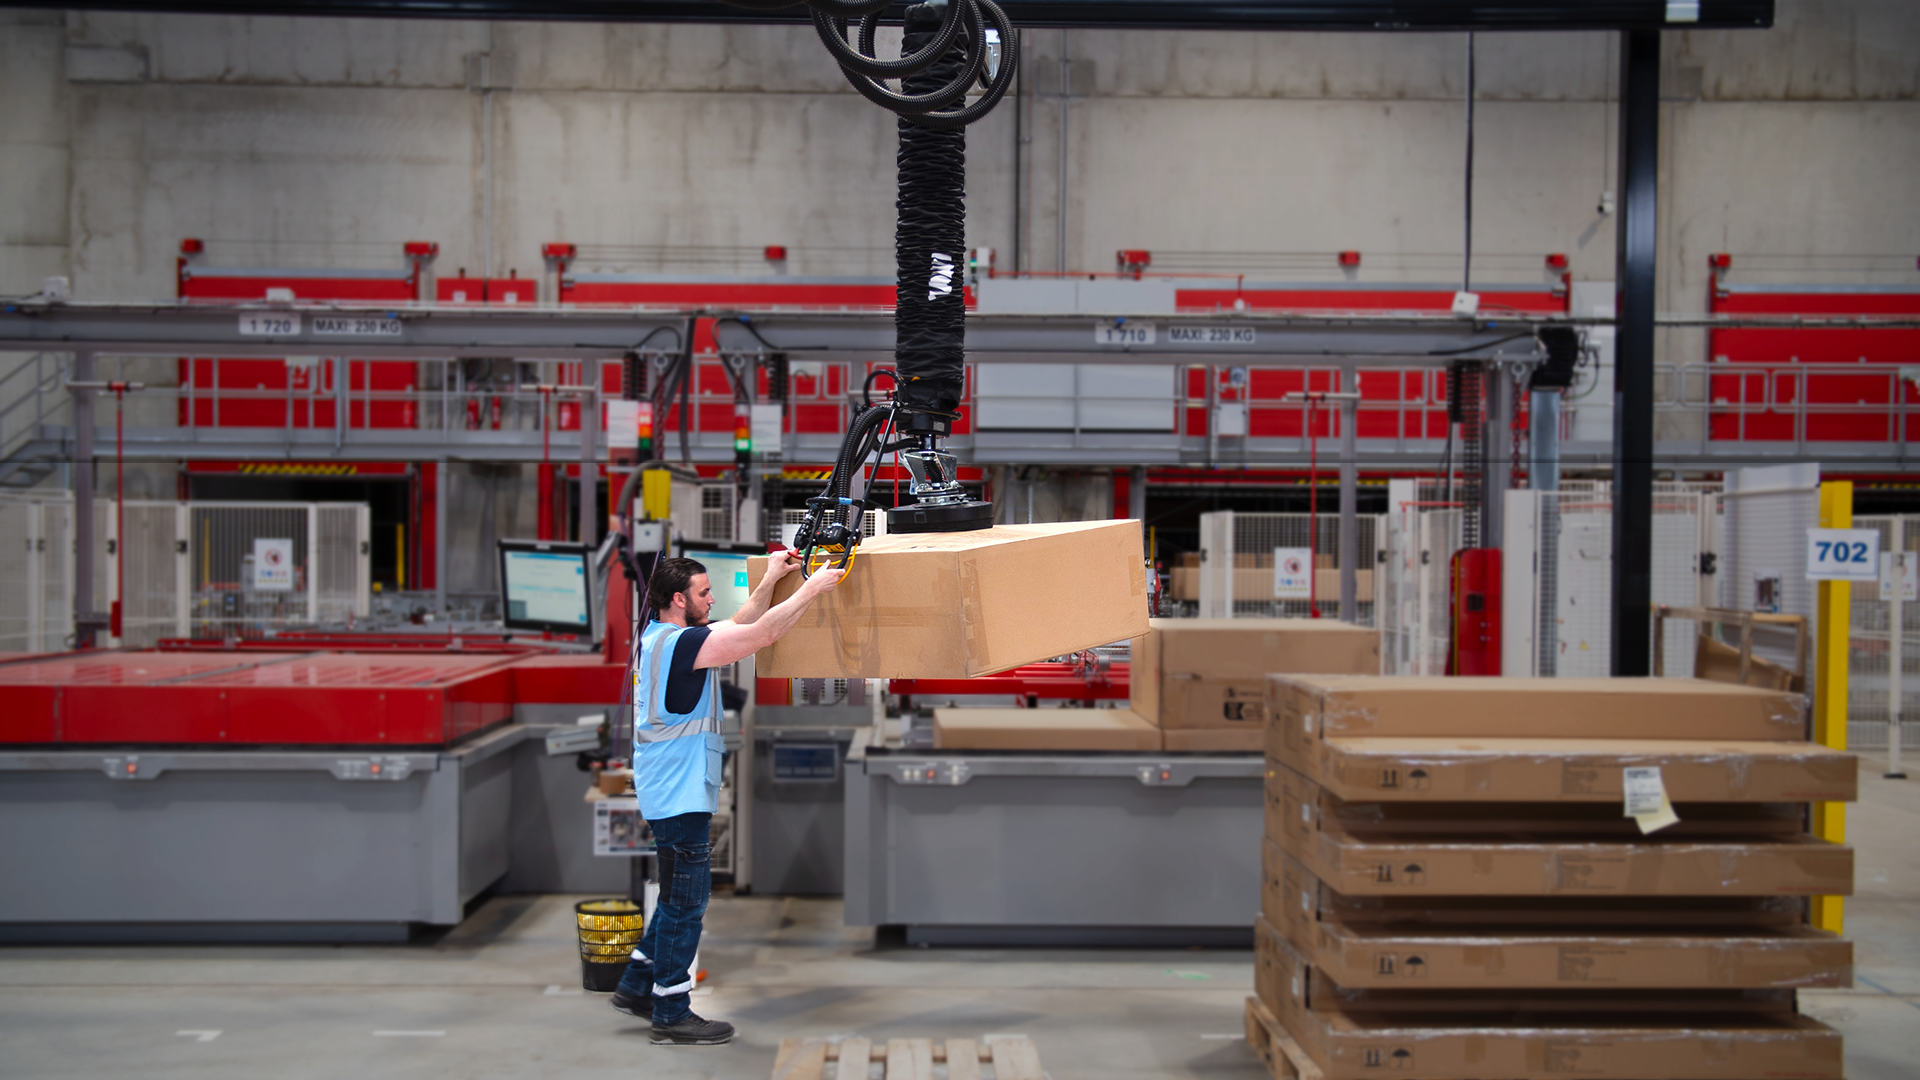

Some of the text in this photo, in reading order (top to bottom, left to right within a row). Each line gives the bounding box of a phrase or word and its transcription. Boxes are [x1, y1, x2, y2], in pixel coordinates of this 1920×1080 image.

[263, 319, 292, 333] 720
[355, 320, 377, 333] 230
[380, 320, 399, 333] KG
[1119, 329, 1147, 342] 710
[1209, 328, 1231, 342] 230
[1234, 329, 1253, 342] KG
[1815, 541, 1868, 563] 702
